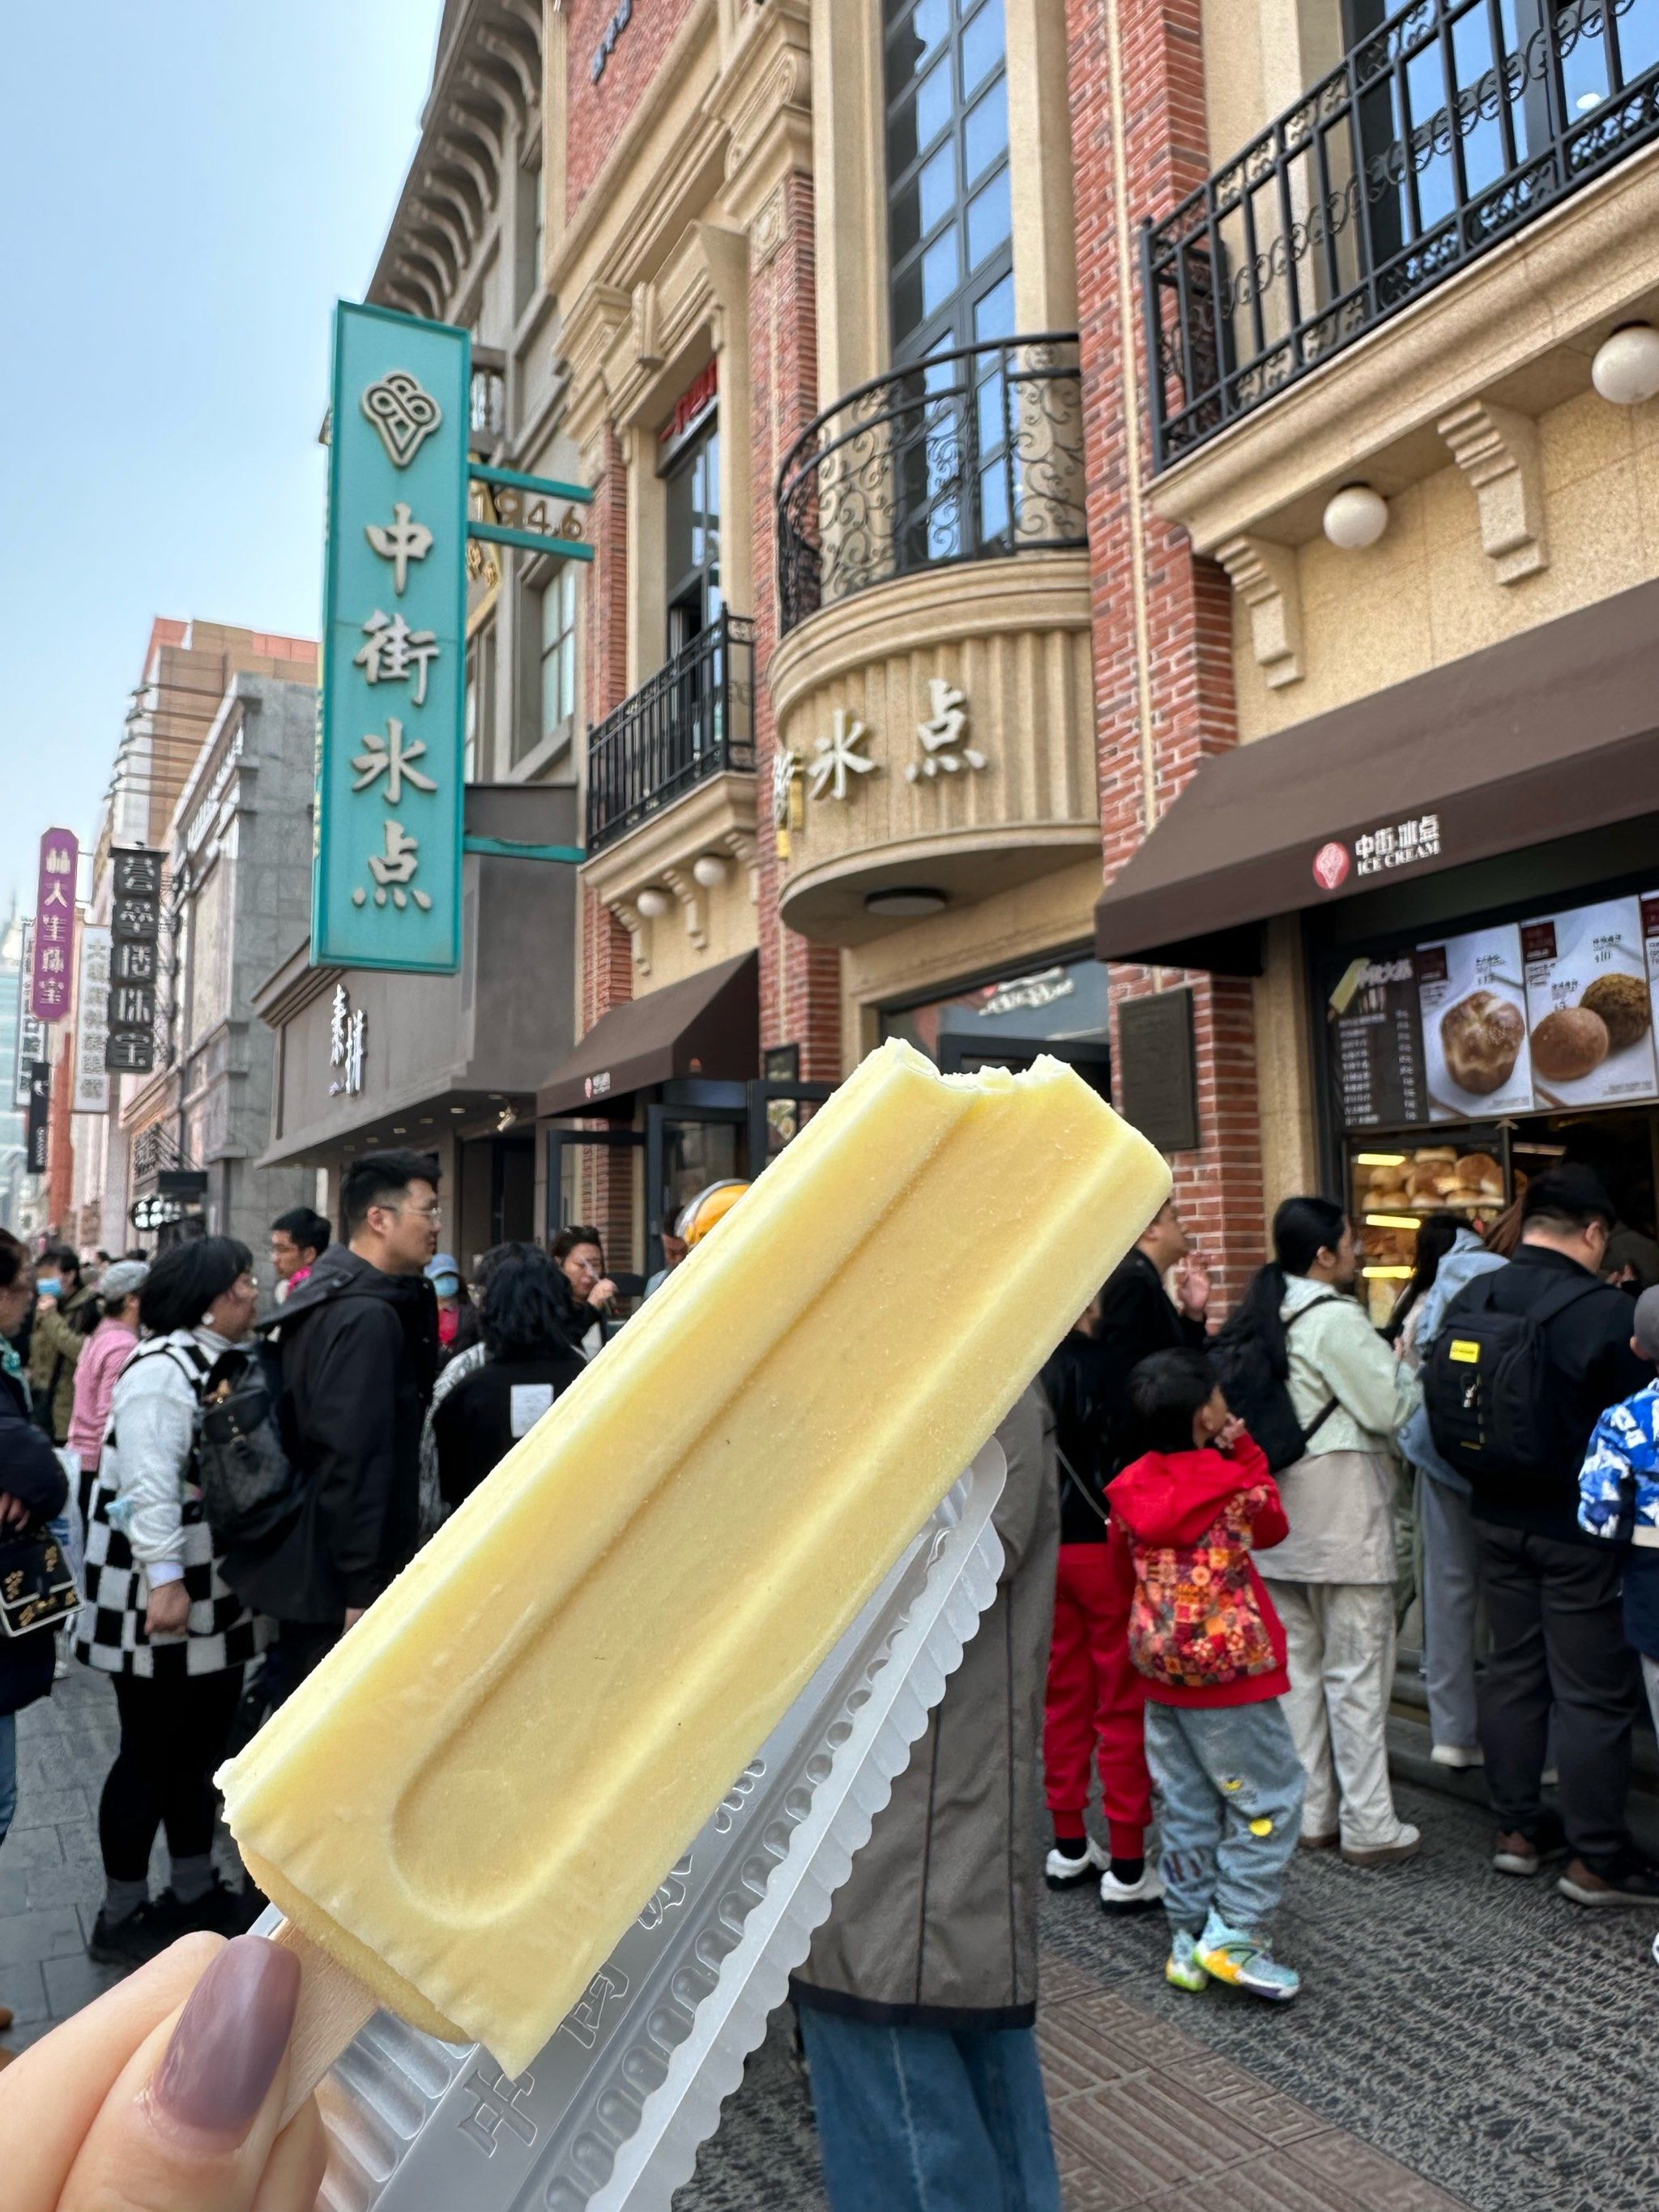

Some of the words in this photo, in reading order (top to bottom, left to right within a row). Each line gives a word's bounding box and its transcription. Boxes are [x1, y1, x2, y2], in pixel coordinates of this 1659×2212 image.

[352, 503, 441, 909] 中街冰点
[1355, 814, 1439, 858] 中街冰点
[1358, 855, 1382, 876] ICE
[1384, 840, 1440, 868] CREAM
